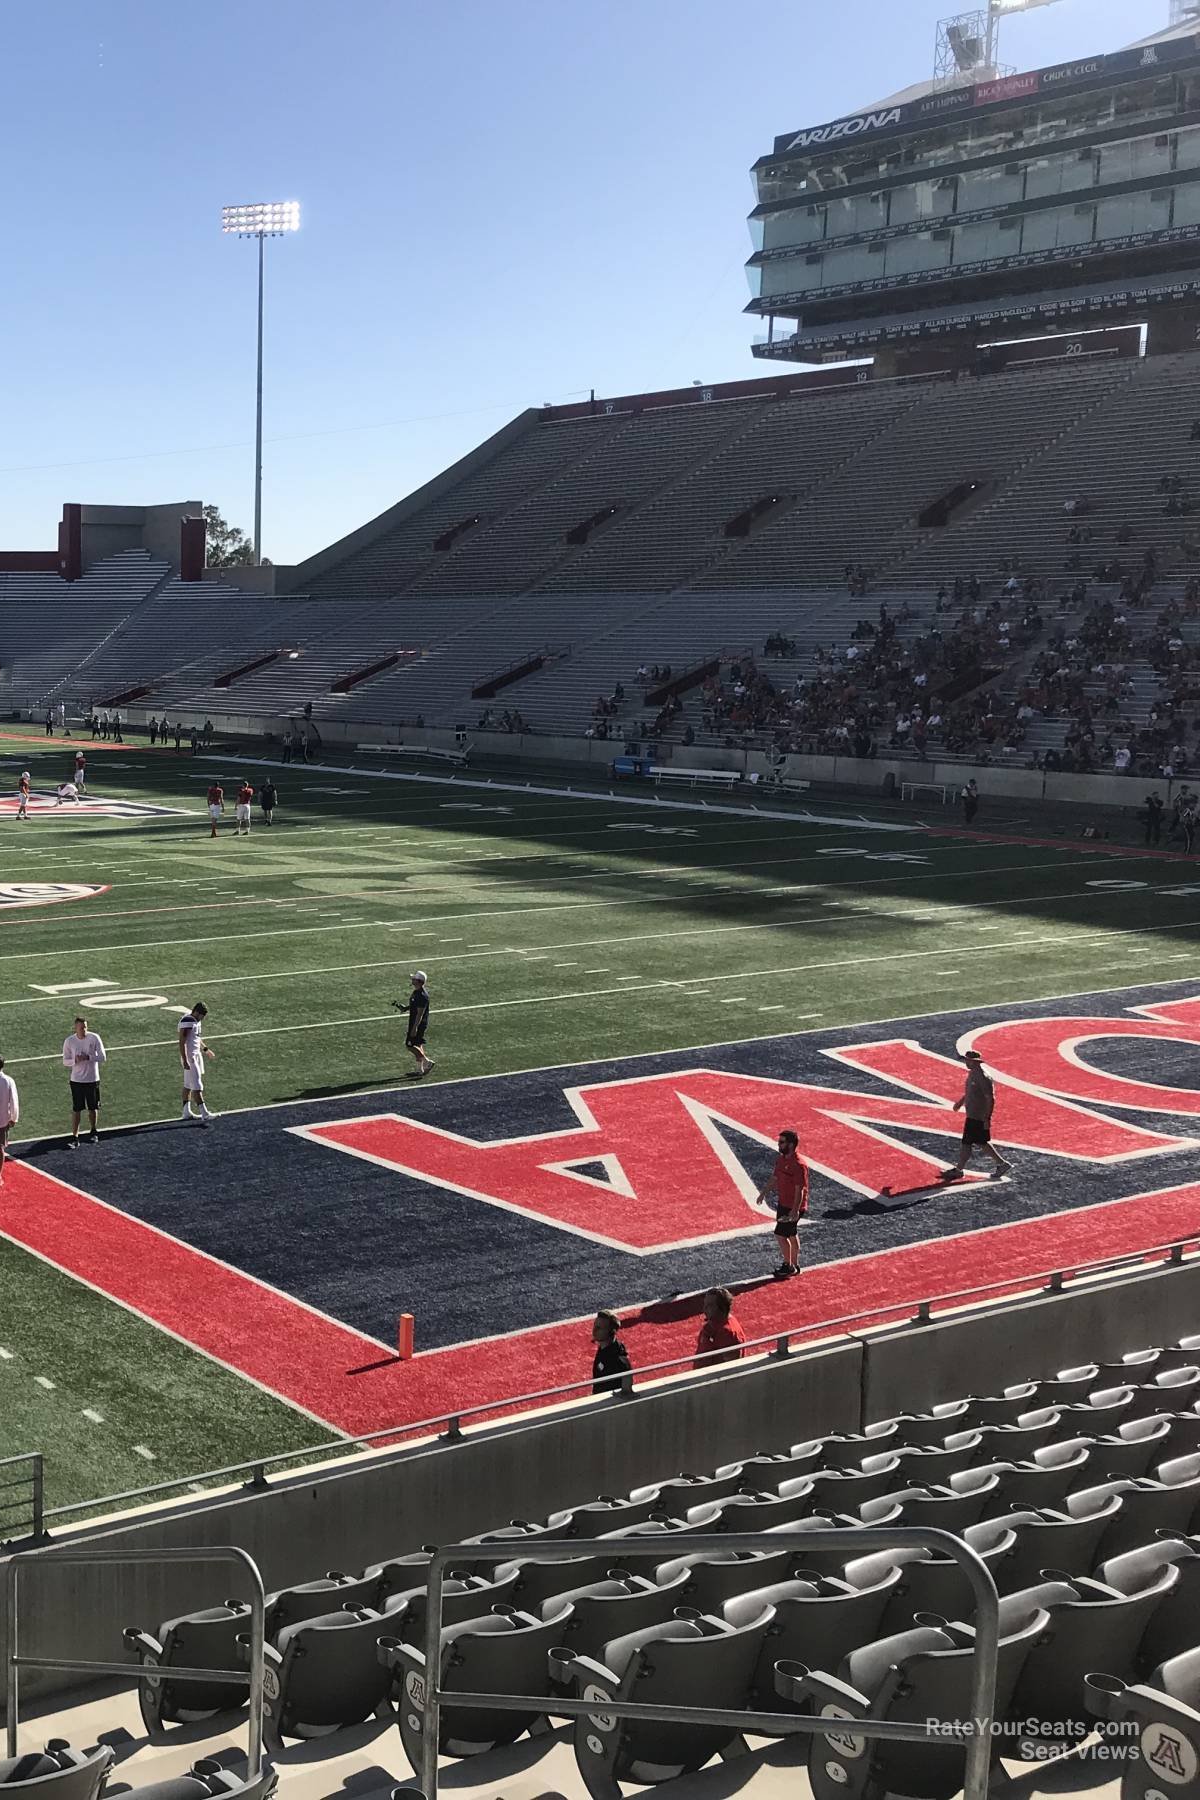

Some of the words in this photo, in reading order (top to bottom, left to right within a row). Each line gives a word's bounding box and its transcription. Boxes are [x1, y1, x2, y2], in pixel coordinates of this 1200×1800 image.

[785, 108, 901, 150] ARIZONA
[1131, 289, 1147, 297] TOM
[1059, 298, 1086, 308] WILSON
[1090, 296, 1103, 304] TED
[1066, 343, 1082, 355] 20
[856, 371, 867, 382] 19
[702, 391, 712, 401] 18
[604, 404, 614, 414] 17
[28, 978, 170, 1010] 10
[1149, 1732, 1186, 1778] A
